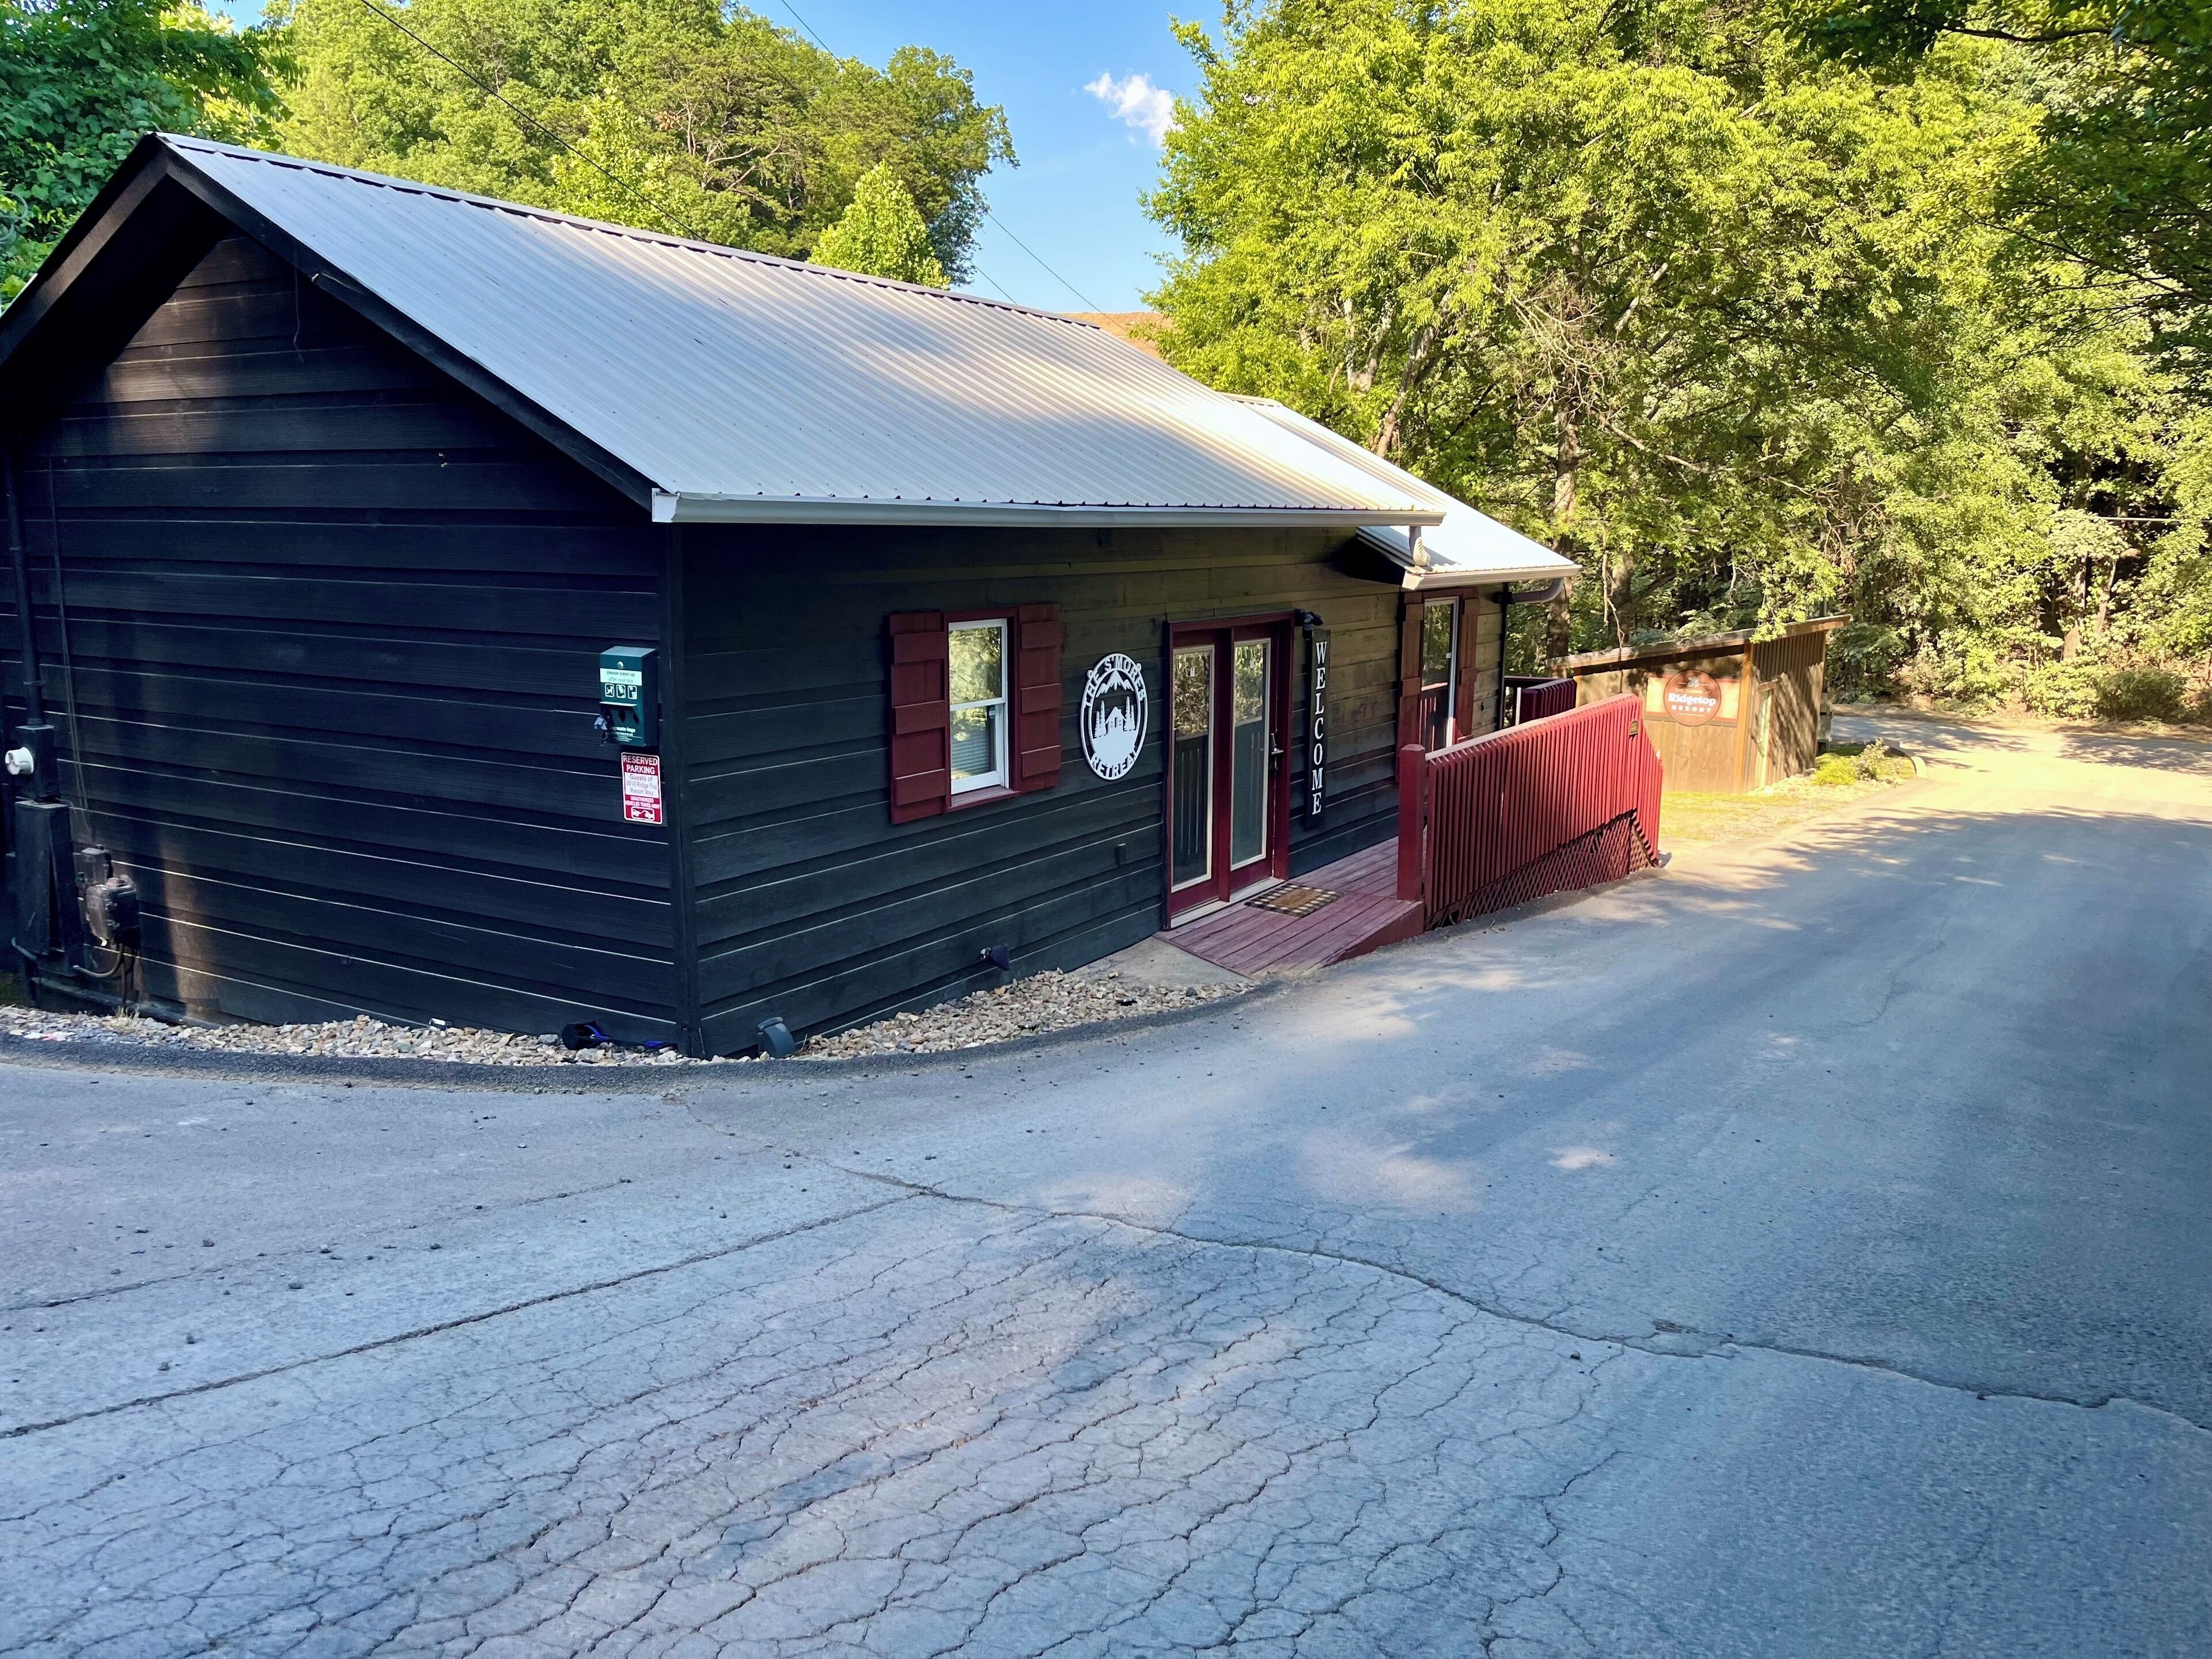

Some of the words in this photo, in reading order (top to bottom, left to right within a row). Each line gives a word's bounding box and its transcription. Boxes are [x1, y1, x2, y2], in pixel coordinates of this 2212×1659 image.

[1084, 671, 1103, 709] THE
[1104, 655, 1146, 702] S'MORES
[1668, 692, 1717, 707] Ridgetop
[1671, 704, 1711, 713] RESORT
[1312, 641, 1327, 815] WELCOME
[623, 755, 658, 766] RESERVED
[1090, 748, 1137, 777] RETREAT
[626, 764, 656, 774] PARKING
